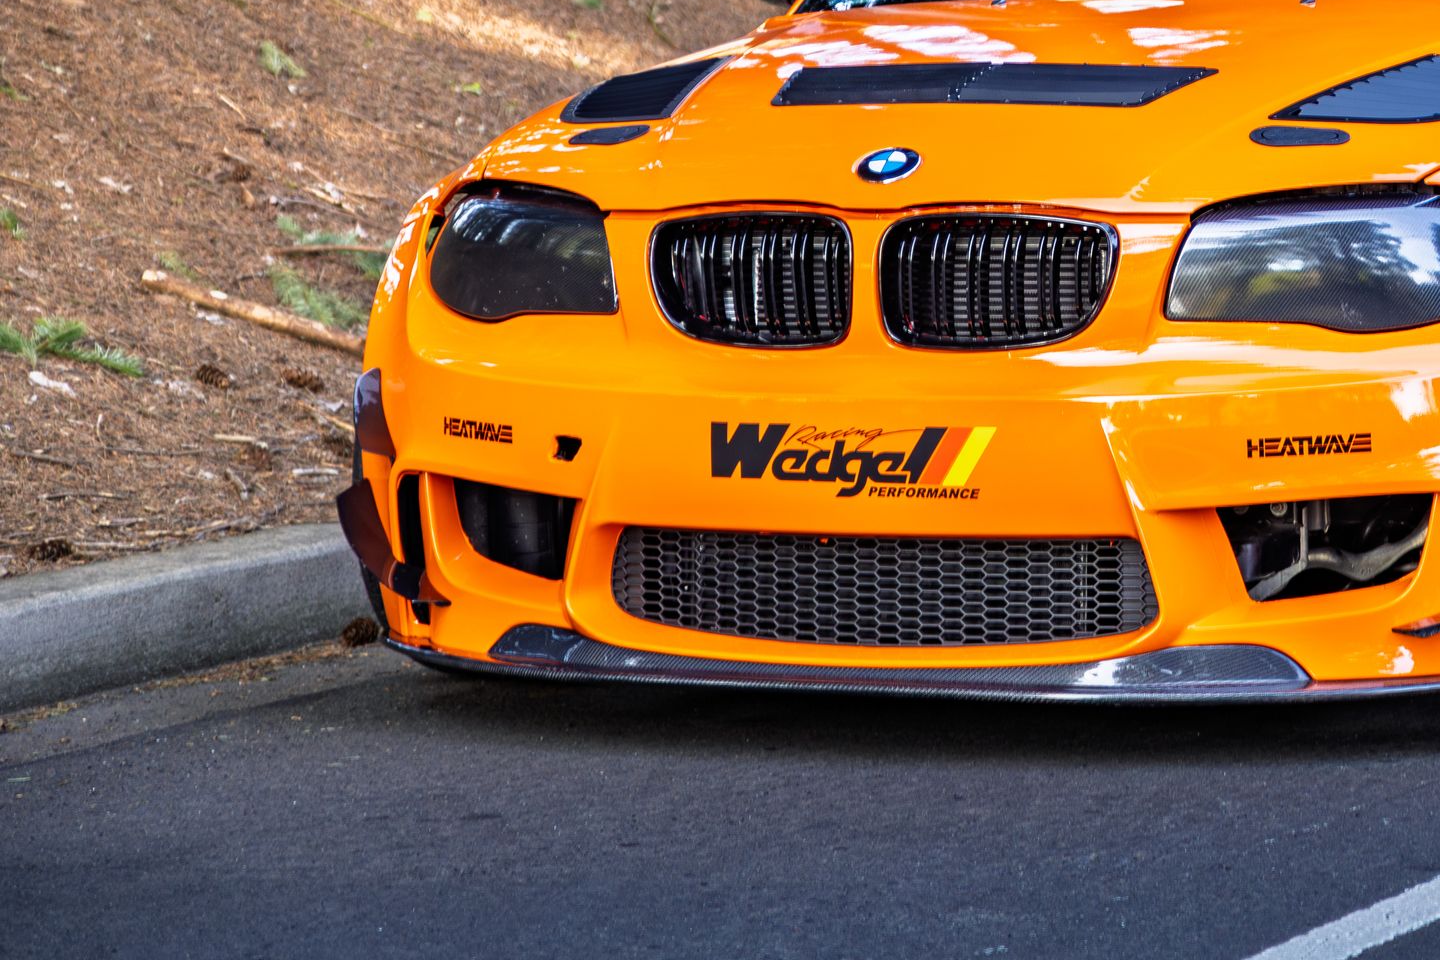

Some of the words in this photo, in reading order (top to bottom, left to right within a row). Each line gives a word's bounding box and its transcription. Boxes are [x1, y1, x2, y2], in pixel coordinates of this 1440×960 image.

[444, 416, 512, 444] HEATWAVE
[784, 424, 883, 453] Racing
[1247, 433, 1371, 458] HEATWAVE
[868, 486, 980, 500] PERFORMANCE
